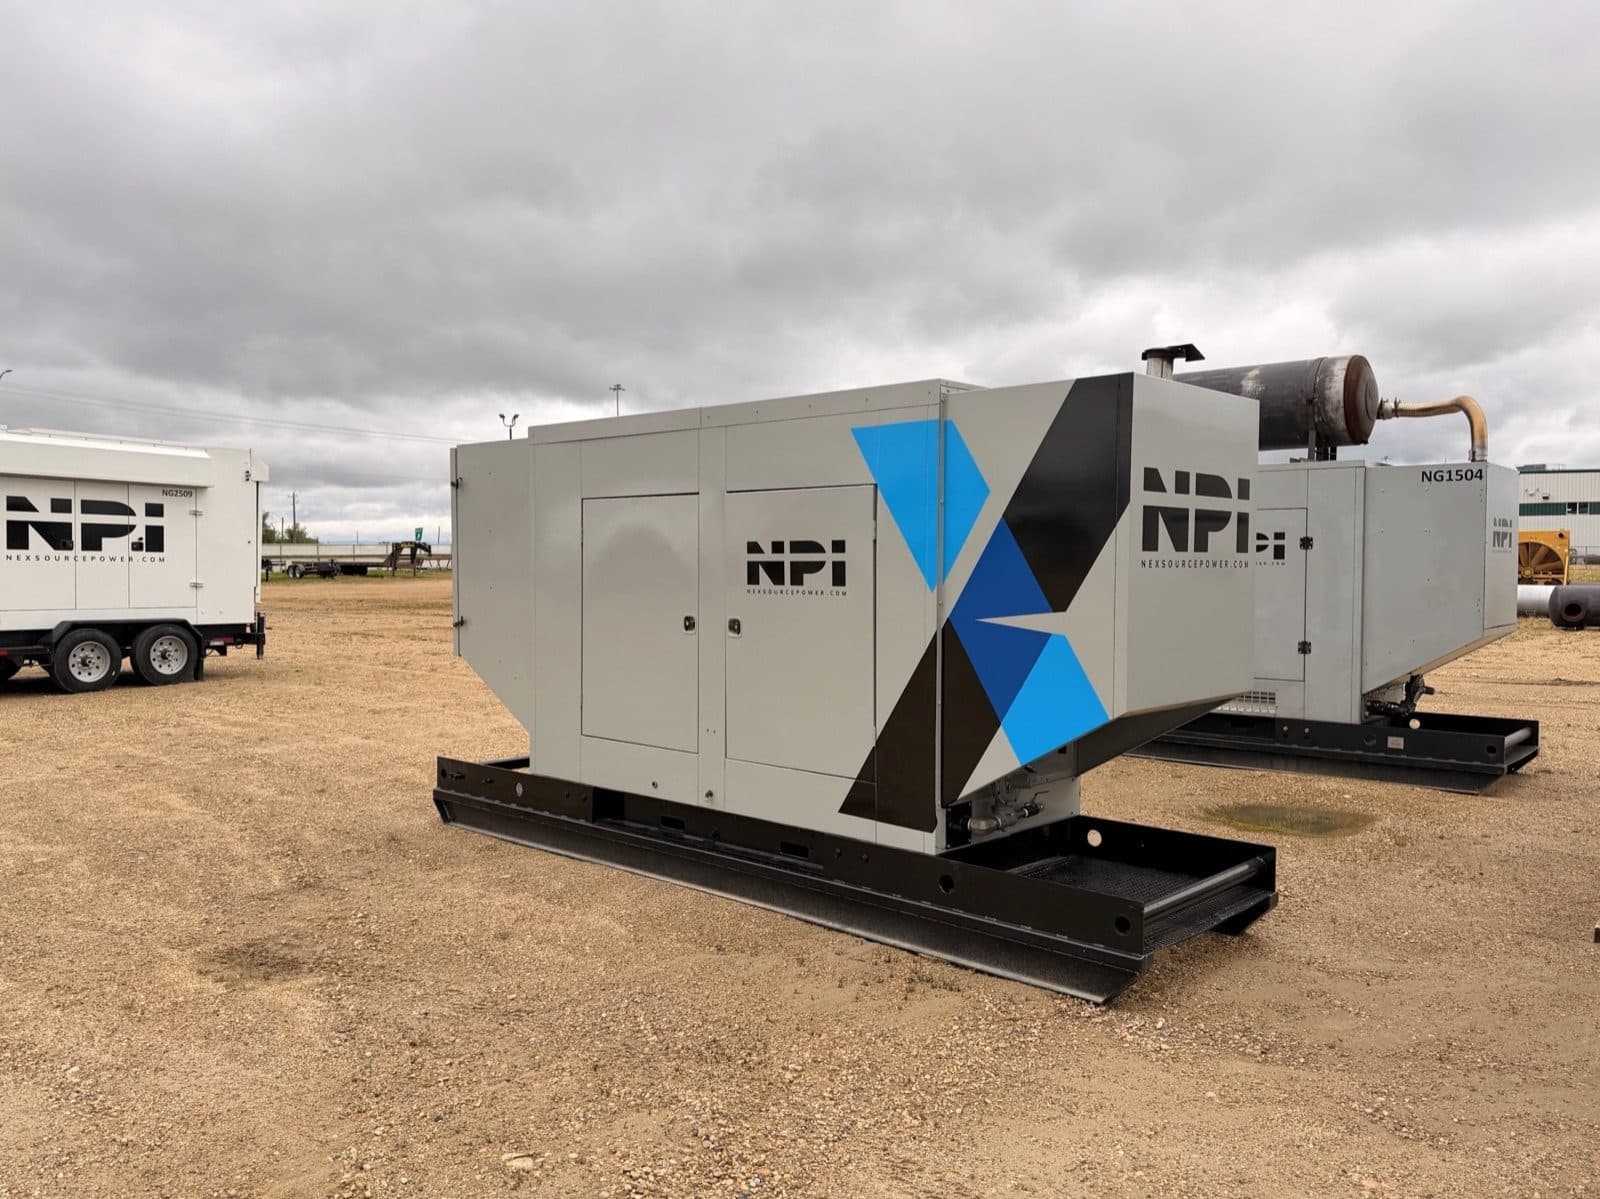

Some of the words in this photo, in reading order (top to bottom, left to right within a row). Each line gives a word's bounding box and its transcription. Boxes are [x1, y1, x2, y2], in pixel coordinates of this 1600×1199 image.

[1421, 469, 1483, 482] NG1504
[161, 488, 193, 498] NG2509
[1142, 467, 1250, 553] NPI
[6, 496, 164, 553] NPI
[6, 554, 165, 563] NEXSOURCEPOWER.COM
[747, 540, 846, 586] NPI
[1141, 560, 1249, 569] NEXSOURCEPOWER.COM
